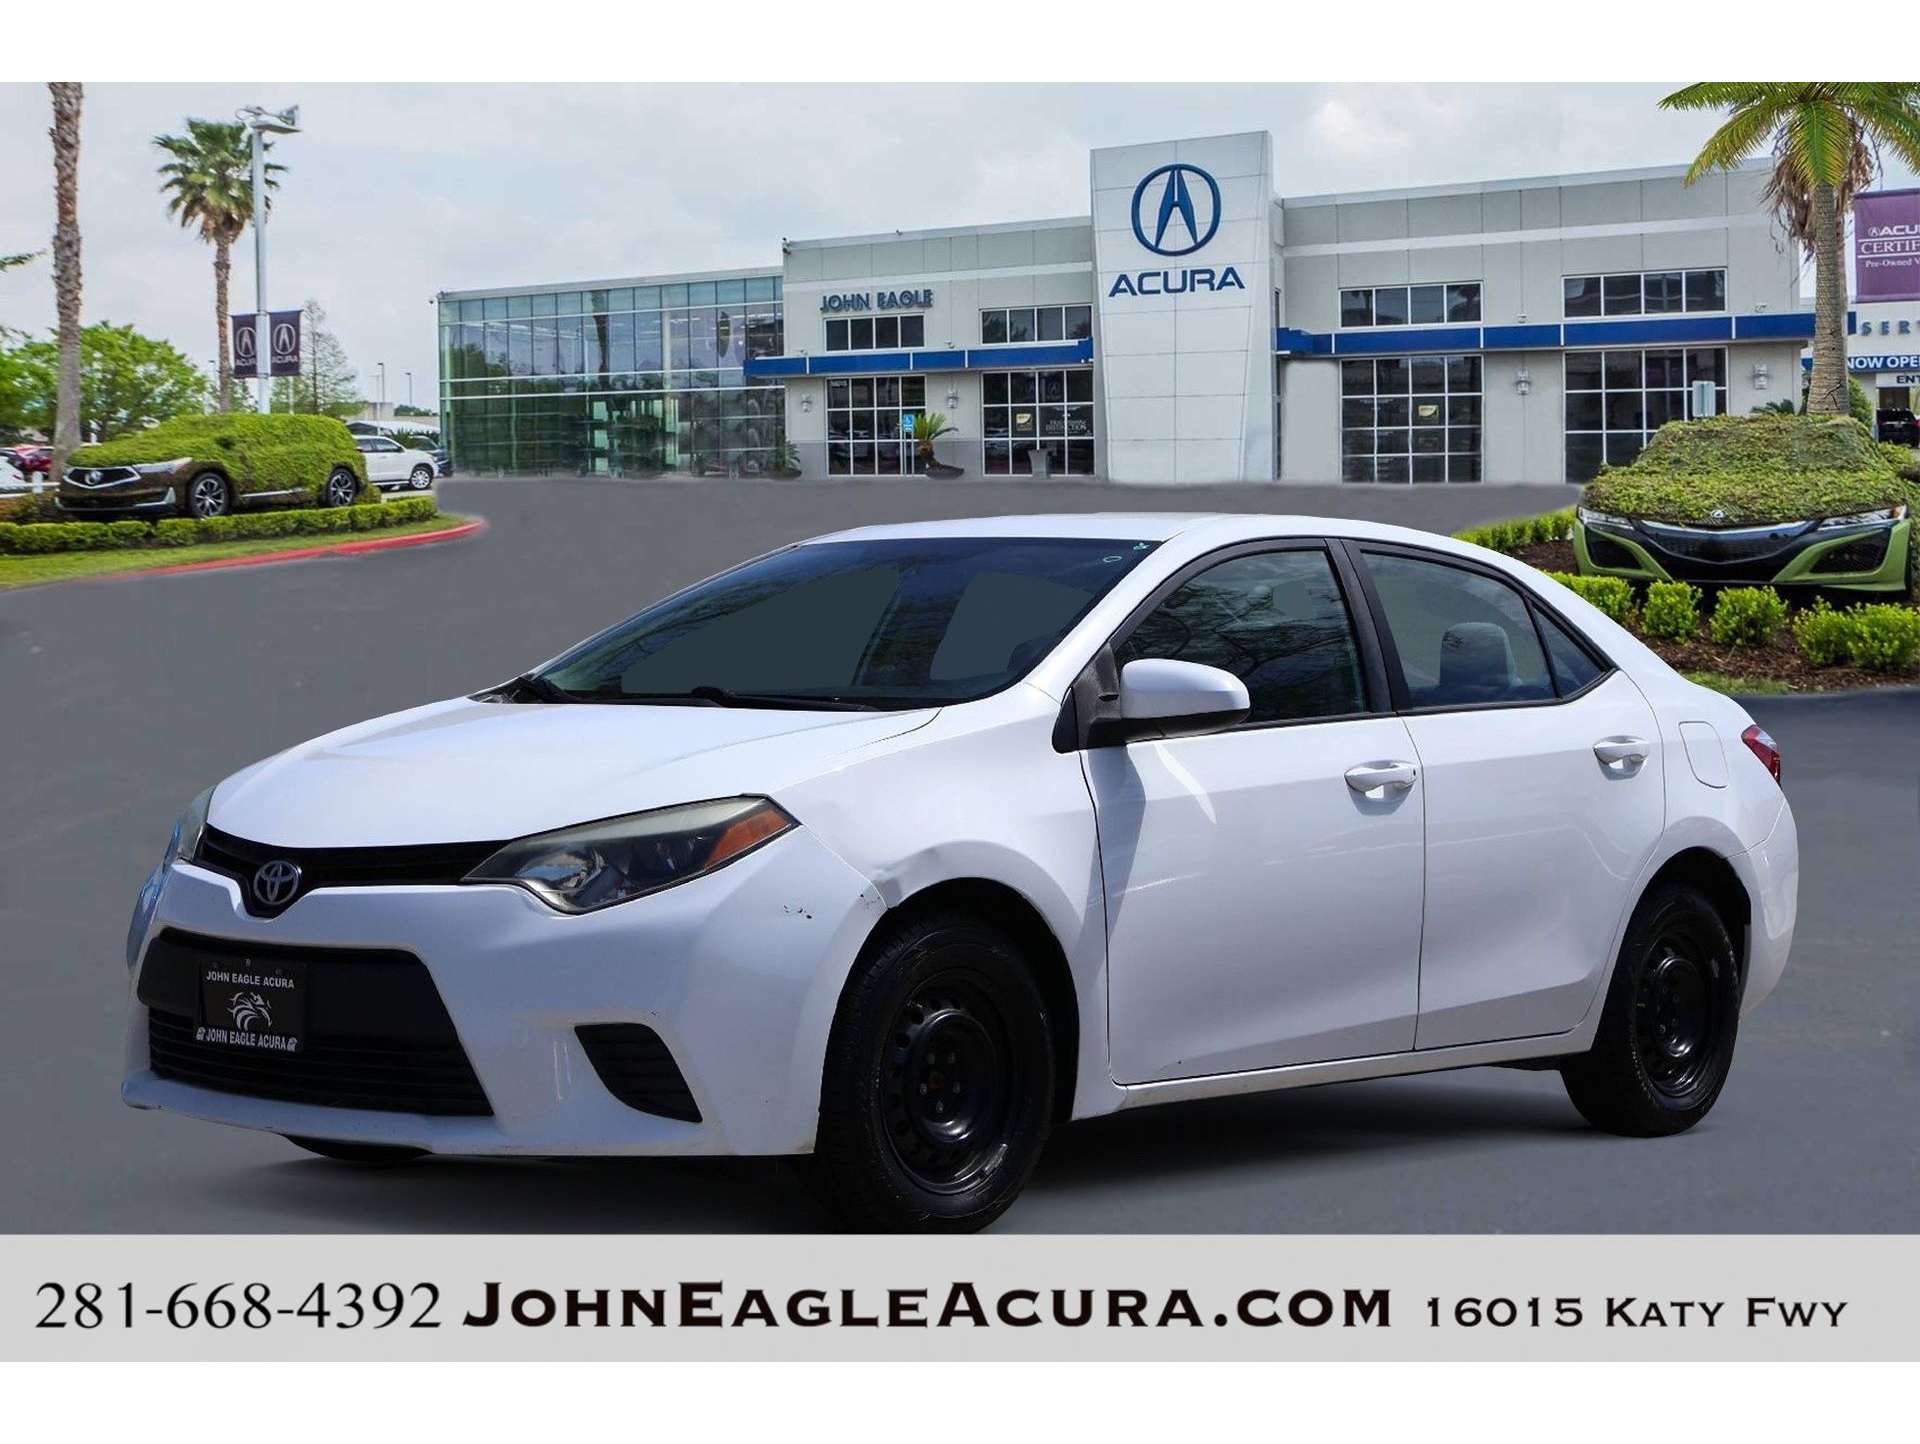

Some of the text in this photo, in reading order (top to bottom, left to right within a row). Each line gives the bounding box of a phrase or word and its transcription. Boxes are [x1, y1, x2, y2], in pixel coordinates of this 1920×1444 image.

[1880, 225, 1920, 236] ACU
[1866, 259, 1912, 267] Pre-Owned
[1109, 267, 1245, 297] ACURA
[820, 289, 932, 312] JOHN EAGLE
[1861, 320, 1920, 336] SER
[272, 355, 298, 363] ACURA
[1848, 356, 1920, 369] NOW OPE
[206, 971, 295, 988] JOHN EAGLE ACURA
[206, 1028, 286, 1050] JOHN EAGLE ACURA
